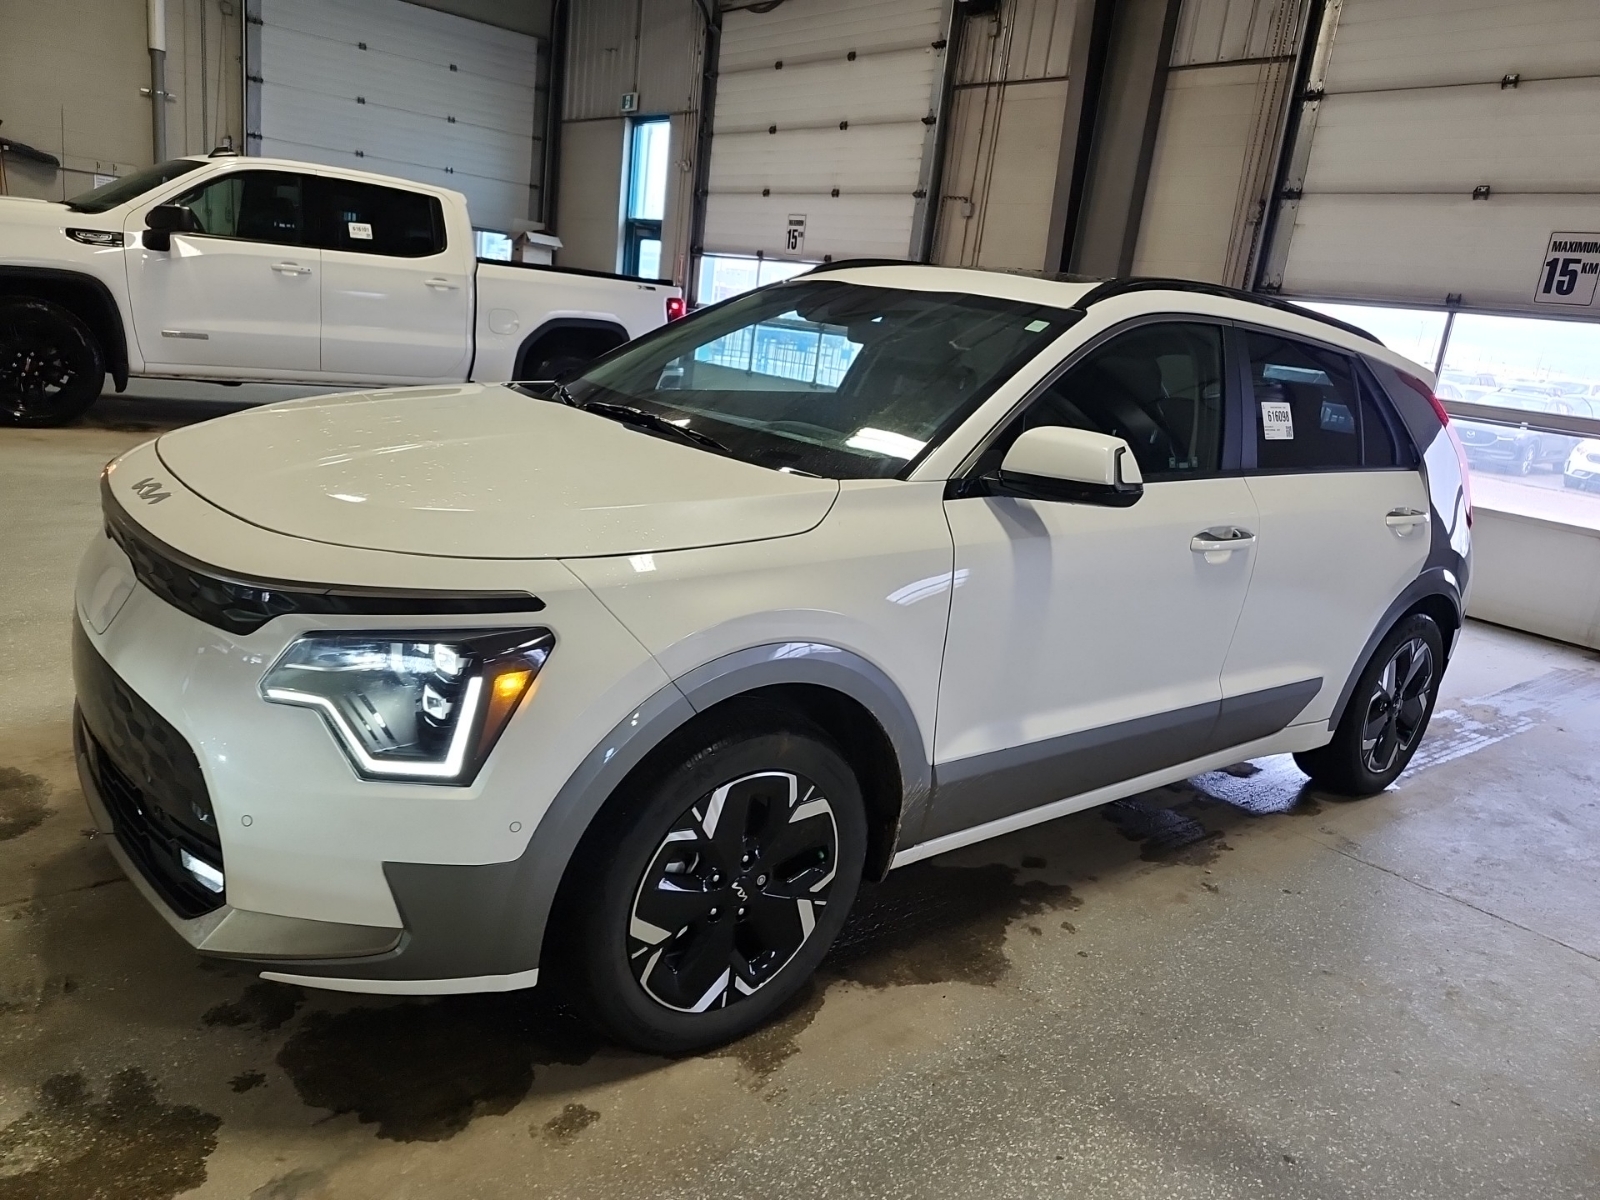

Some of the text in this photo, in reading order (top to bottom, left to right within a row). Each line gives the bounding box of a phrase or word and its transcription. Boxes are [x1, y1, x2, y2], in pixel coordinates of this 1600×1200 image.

[787, 229, 798, 250] 15
[1551, 241, 1600, 253] MAXIMUM
[1542, 257, 1599, 296] 15 KM
[1267, 410, 1290, 423] 616098
